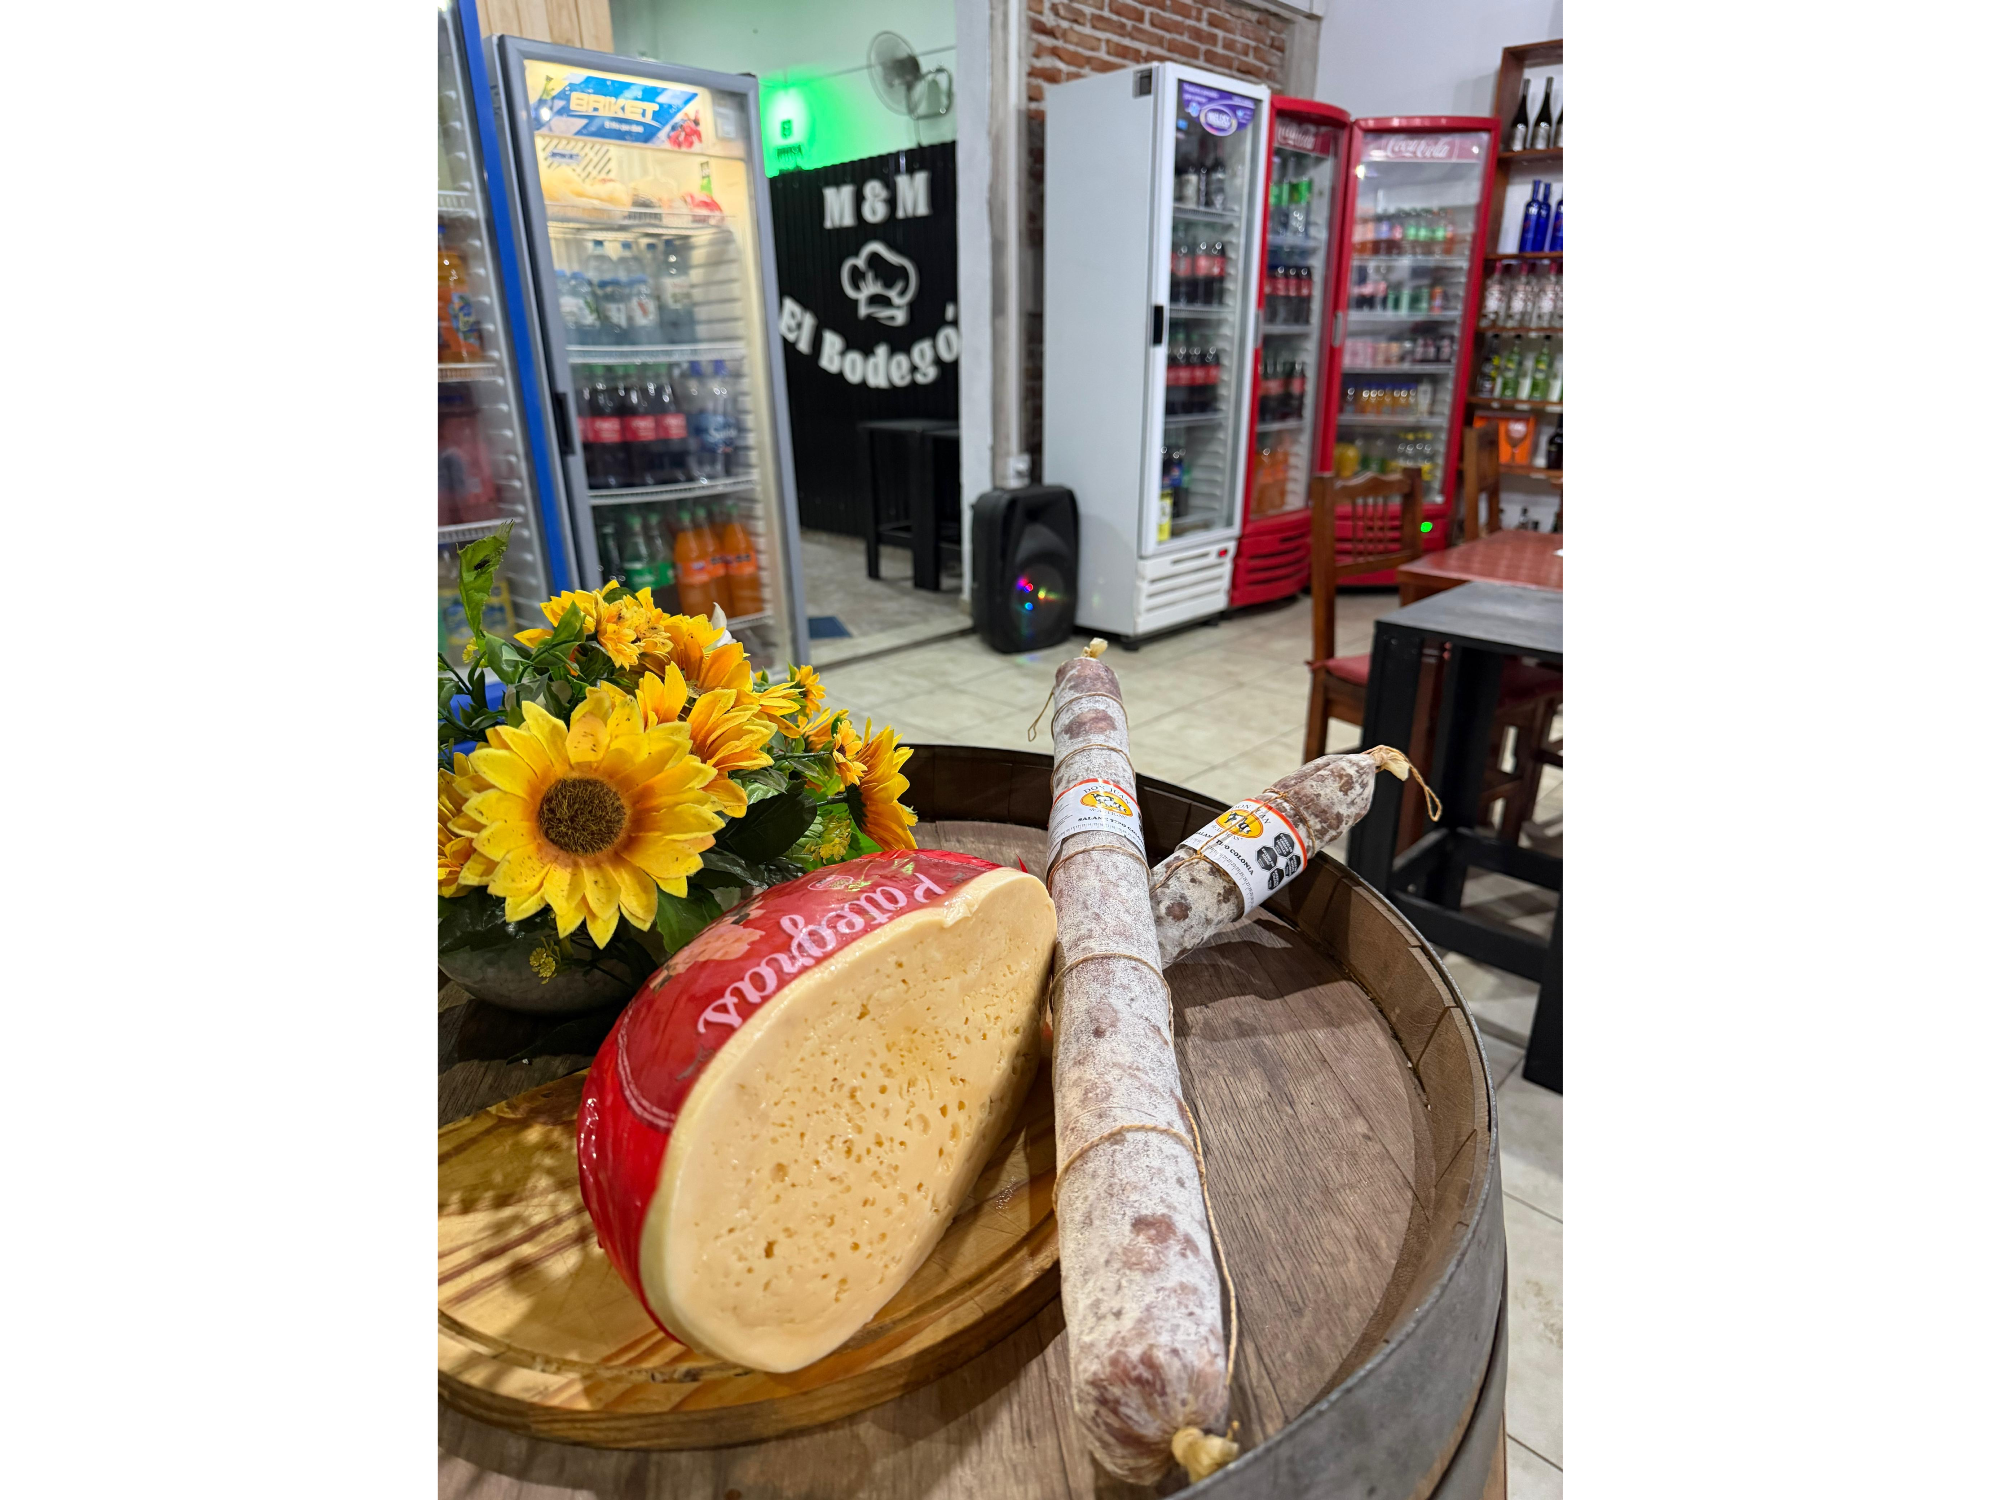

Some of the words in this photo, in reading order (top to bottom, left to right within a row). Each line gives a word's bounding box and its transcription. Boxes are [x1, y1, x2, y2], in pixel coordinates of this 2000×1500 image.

[570, 91, 659, 121] BRIKET
[822, 183, 858, 229] M
[861, 178, 891, 224] &
[894, 170, 933, 219] M
[779, 295, 818, 354] El
[1229, 849, 1255, 876] COLONIA
[697, 872, 946, 1034] Pategras
